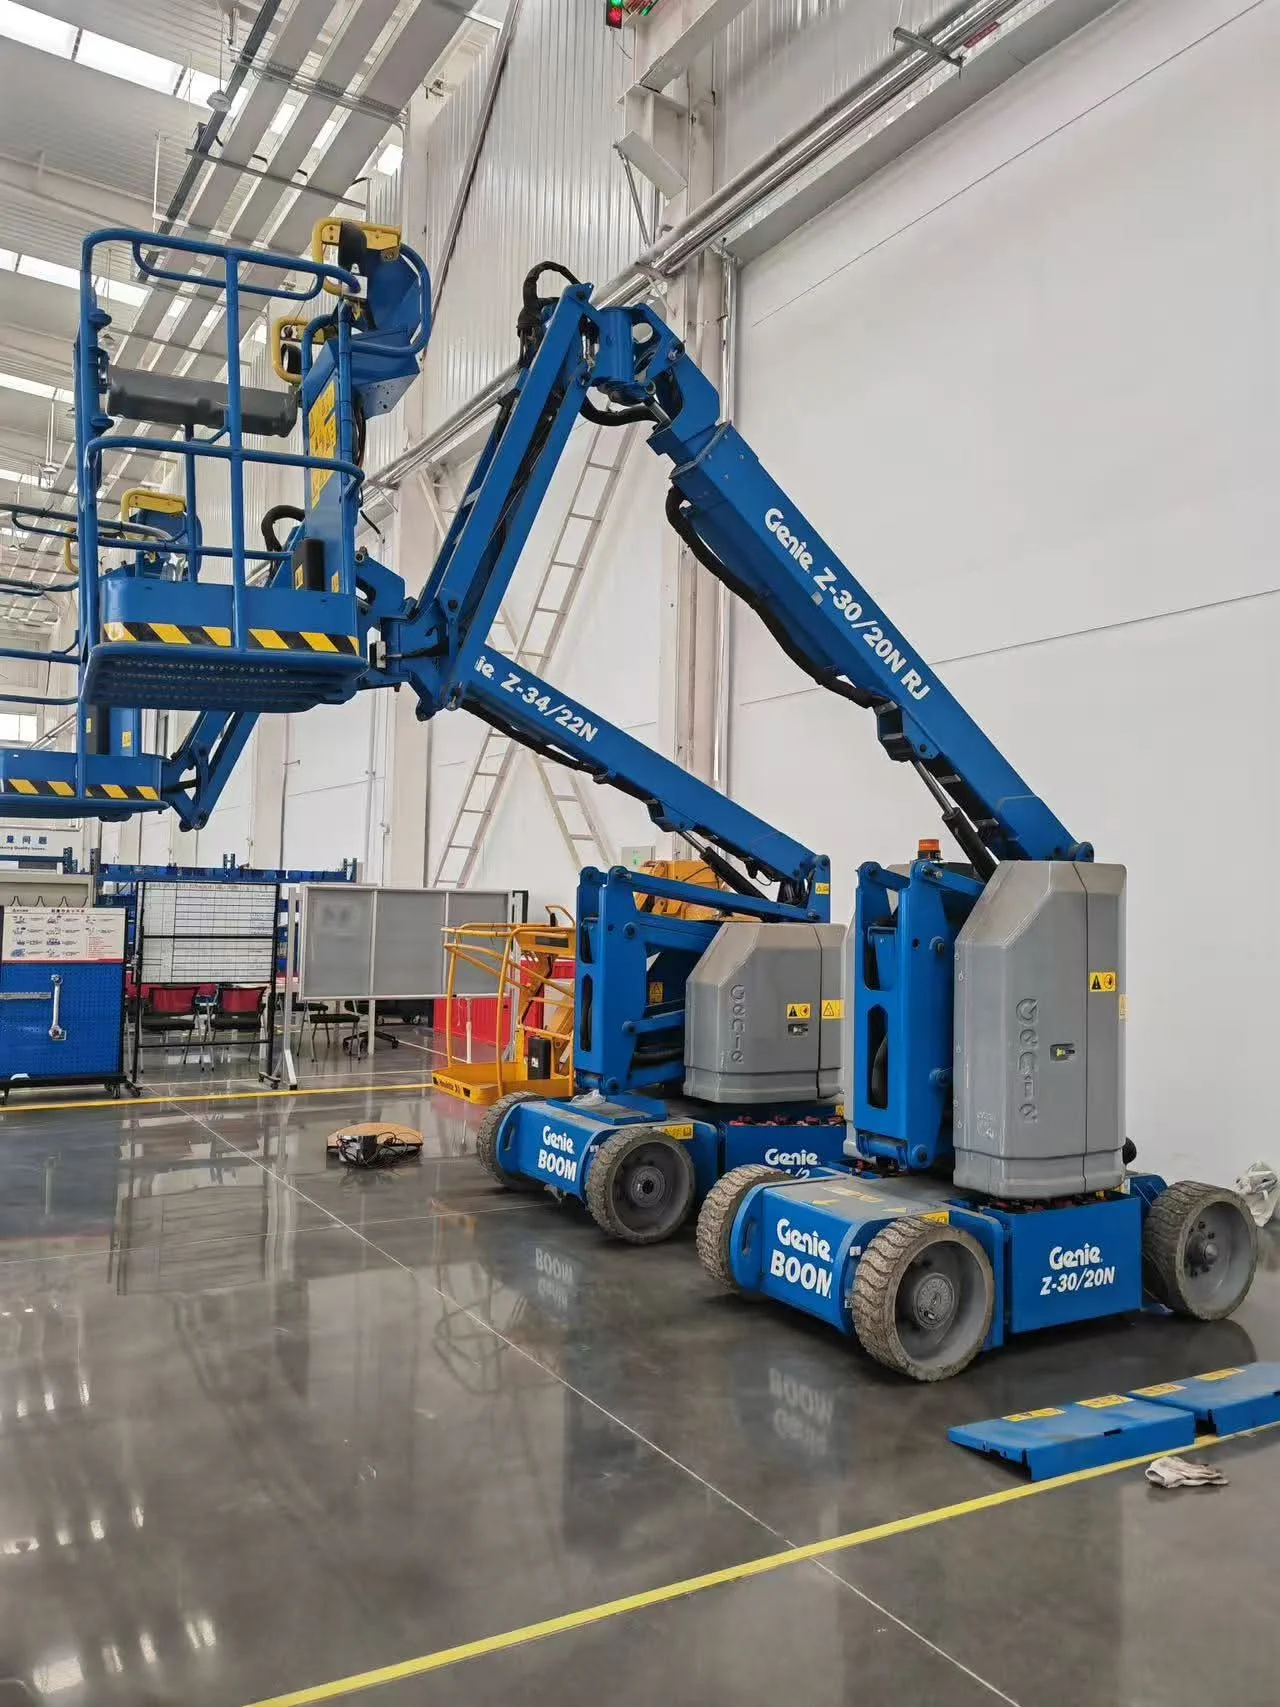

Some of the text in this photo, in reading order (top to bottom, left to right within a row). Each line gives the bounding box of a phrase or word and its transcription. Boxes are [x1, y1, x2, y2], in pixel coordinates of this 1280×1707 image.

[764, 507, 930, 700] Genie Z-30/20N RJ
[500, 672, 598, 743] Z-34/22N
[543, 1125, 574, 1154] Genie
[538, 1149, 577, 1182] BOOM
[765, 1148, 819, 1166] Genie
[776, 1218, 833, 1263] Genie
[1049, 1242, 1103, 1270] Genie
[770, 1249, 832, 1299] BOOM
[1040, 1266, 1115, 1296] Z-30/20N
